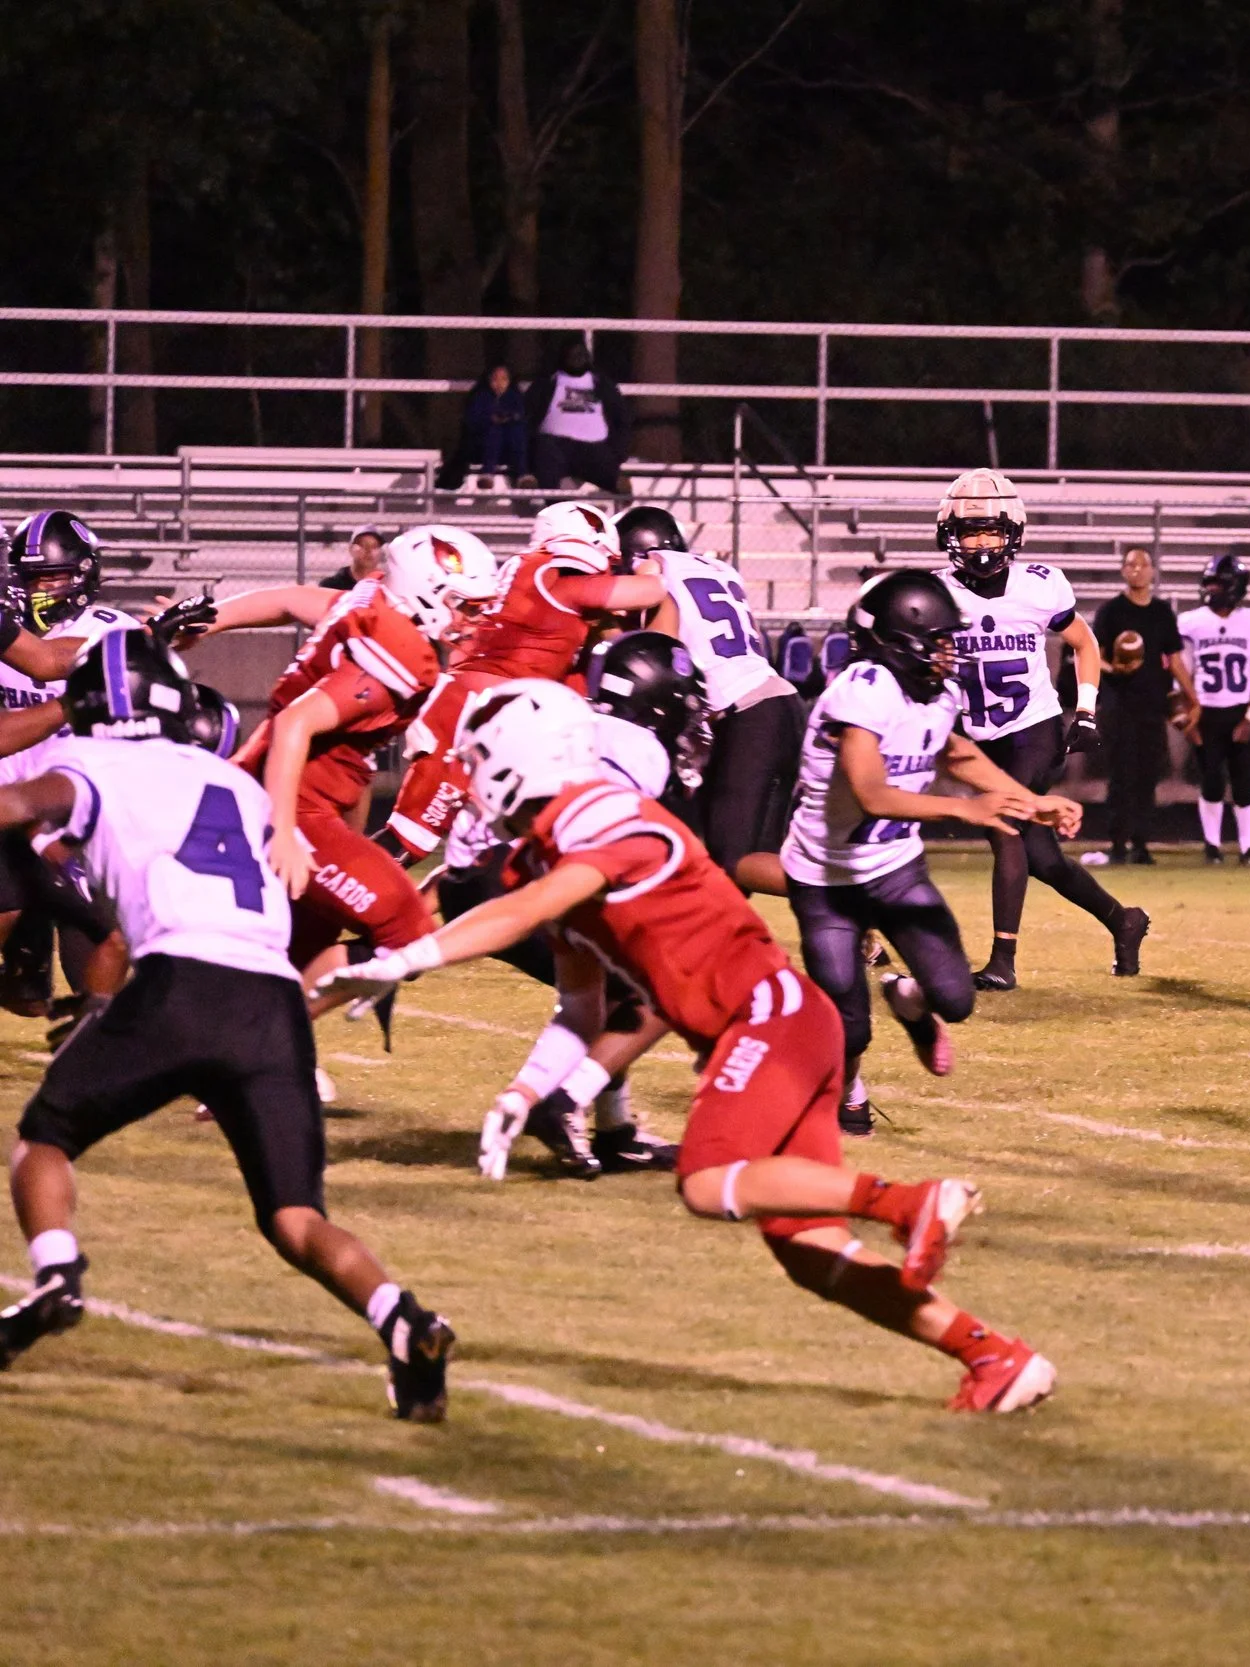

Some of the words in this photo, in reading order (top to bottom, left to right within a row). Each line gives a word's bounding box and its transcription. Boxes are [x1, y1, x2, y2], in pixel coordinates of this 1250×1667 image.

[1026, 564, 1051, 580] 15
[953, 634, 1036, 655] HARAOHS
[959, 658, 1031, 728] 15
[1199, 653, 1248, 693] 50
[174, 784, 265, 915] 4
[314, 863, 378, 914] CARDS
[714, 1035, 770, 1093] CARDS
